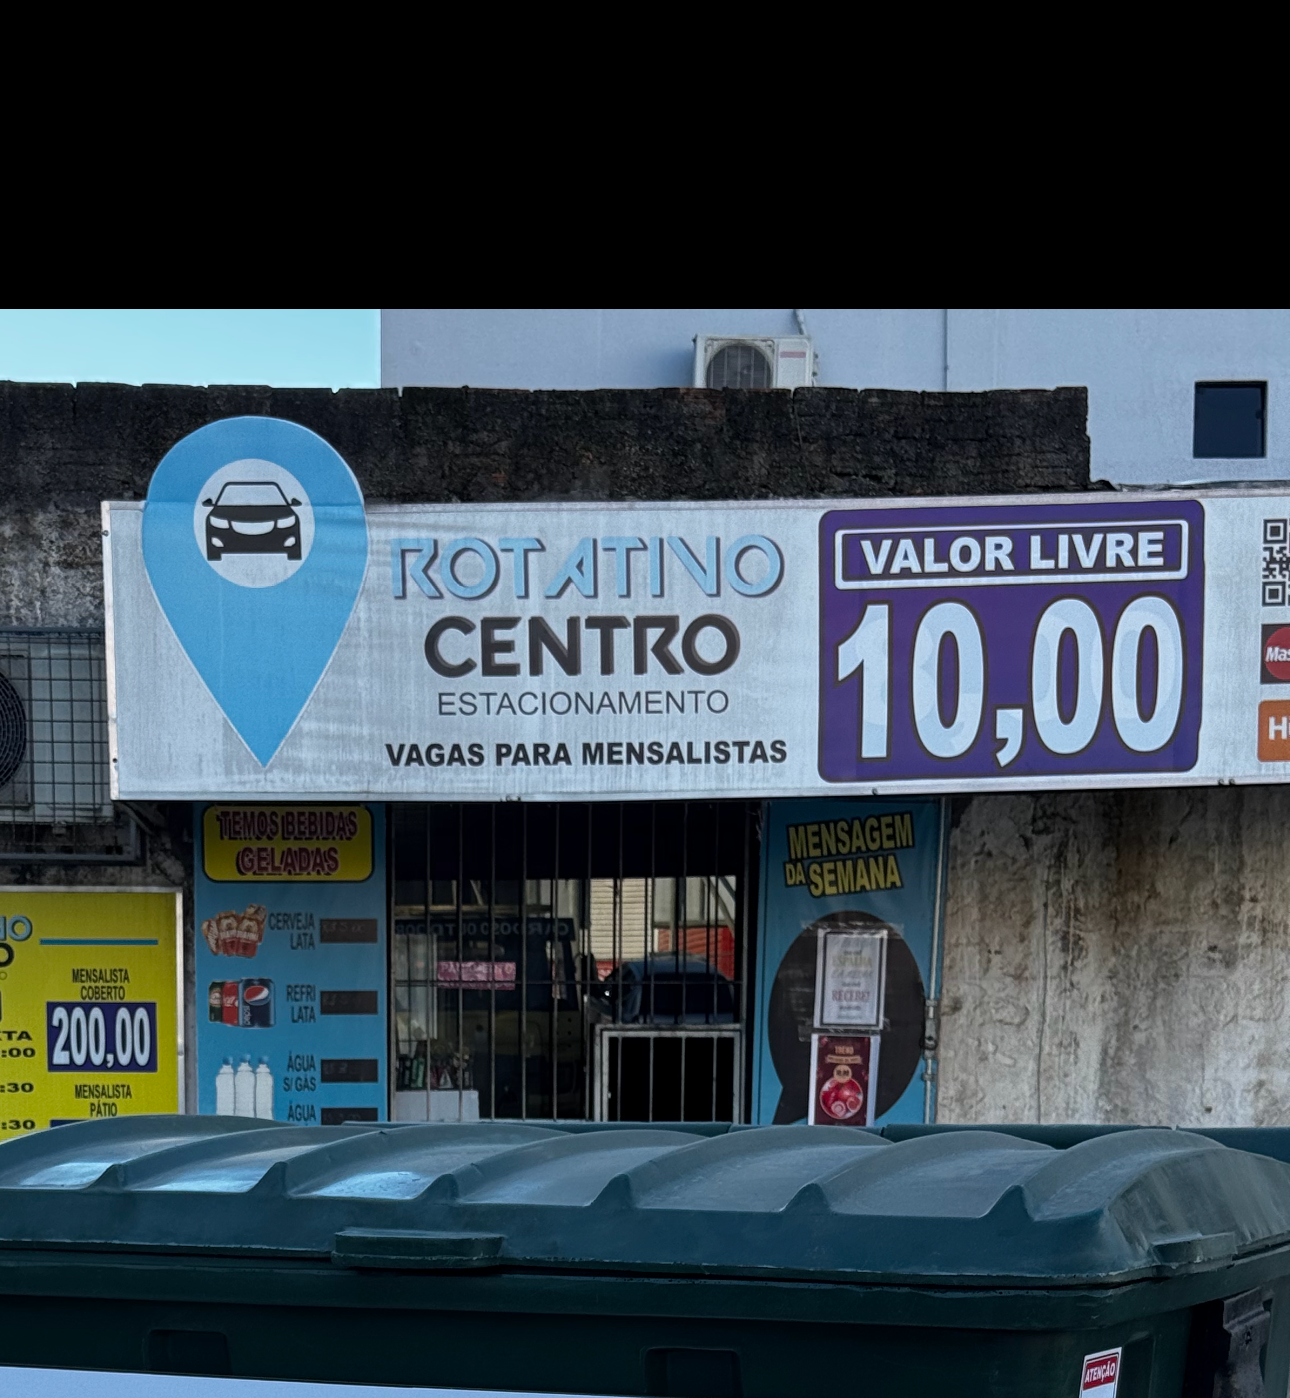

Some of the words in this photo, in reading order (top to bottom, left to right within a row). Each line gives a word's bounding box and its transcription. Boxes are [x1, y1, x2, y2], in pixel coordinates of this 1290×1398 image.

[860, 536, 1014, 575] VALOR
[1030, 531, 1165, 570] LIVRE
[389, 534, 785, 600] ROTATIVO
[423, 613, 741, 678] CENTRO
[837, 595, 1184, 768] 10,00
[438, 689, 729, 716] ESTACIONAMENTO
[386, 742, 485, 767] VAGAS
[496, 743, 571, 766] PARA
[580, 740, 787, 766] MENSALISTAS
[216, 811, 280, 840] TEMOS
[282, 811, 358, 840] BEBIDAS
[787, 813, 913, 859] MENSAGEM
[236, 847, 340, 876] GELADAS
[785, 862, 806, 886] DA
[808, 855, 902, 897] SEMANA
[268, 912, 315, 931] CERVEJA
[290, 933, 315, 950] LATA
[72, 968, 130, 983] MENSALISTA
[80, 986, 125, 1000] COBERTO
[286, 985, 316, 1002] REFRI
[291, 1006, 316, 1023] LATA
[52, 1006, 151, 1069] 200,00
[287, 1050, 316, 1072] ÁGUA
[75, 1084, 132, 1099] MENSALISTA
[90, 1100, 118, 1117] PÁTIO
[1084, 1360, 1115, 1383] ATENÇÃO
